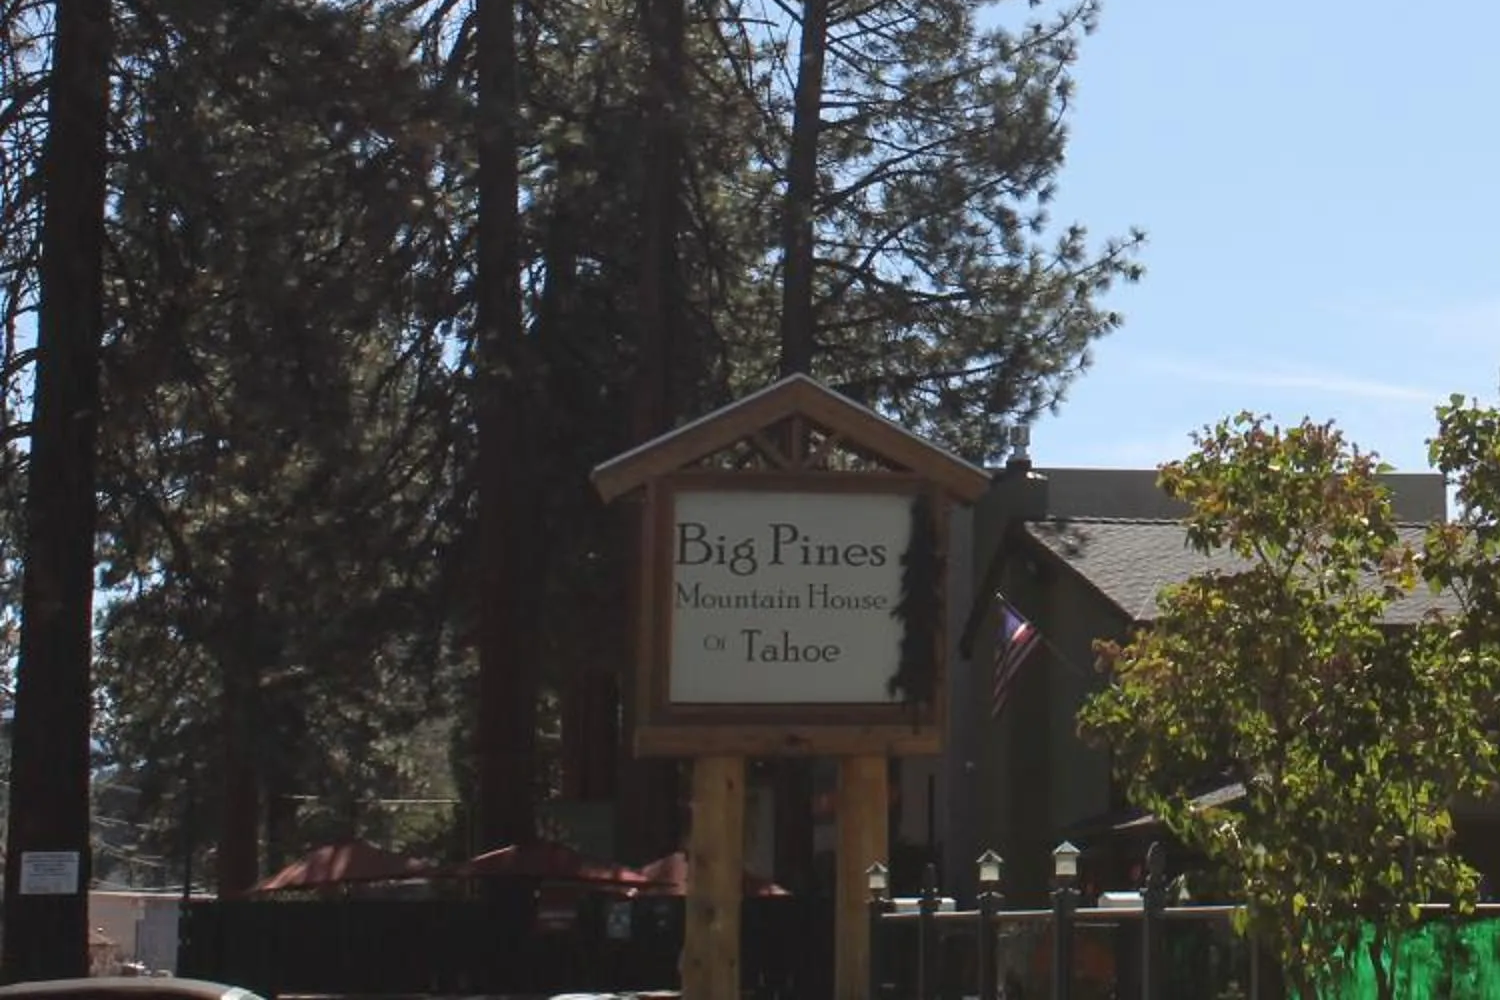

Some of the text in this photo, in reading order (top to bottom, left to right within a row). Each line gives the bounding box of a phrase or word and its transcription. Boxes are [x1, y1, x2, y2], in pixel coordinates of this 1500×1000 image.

[676, 522, 887, 577] Big Pines
[676, 582, 888, 609] Mountain House
[741, 629, 841, 663] Tahoe
